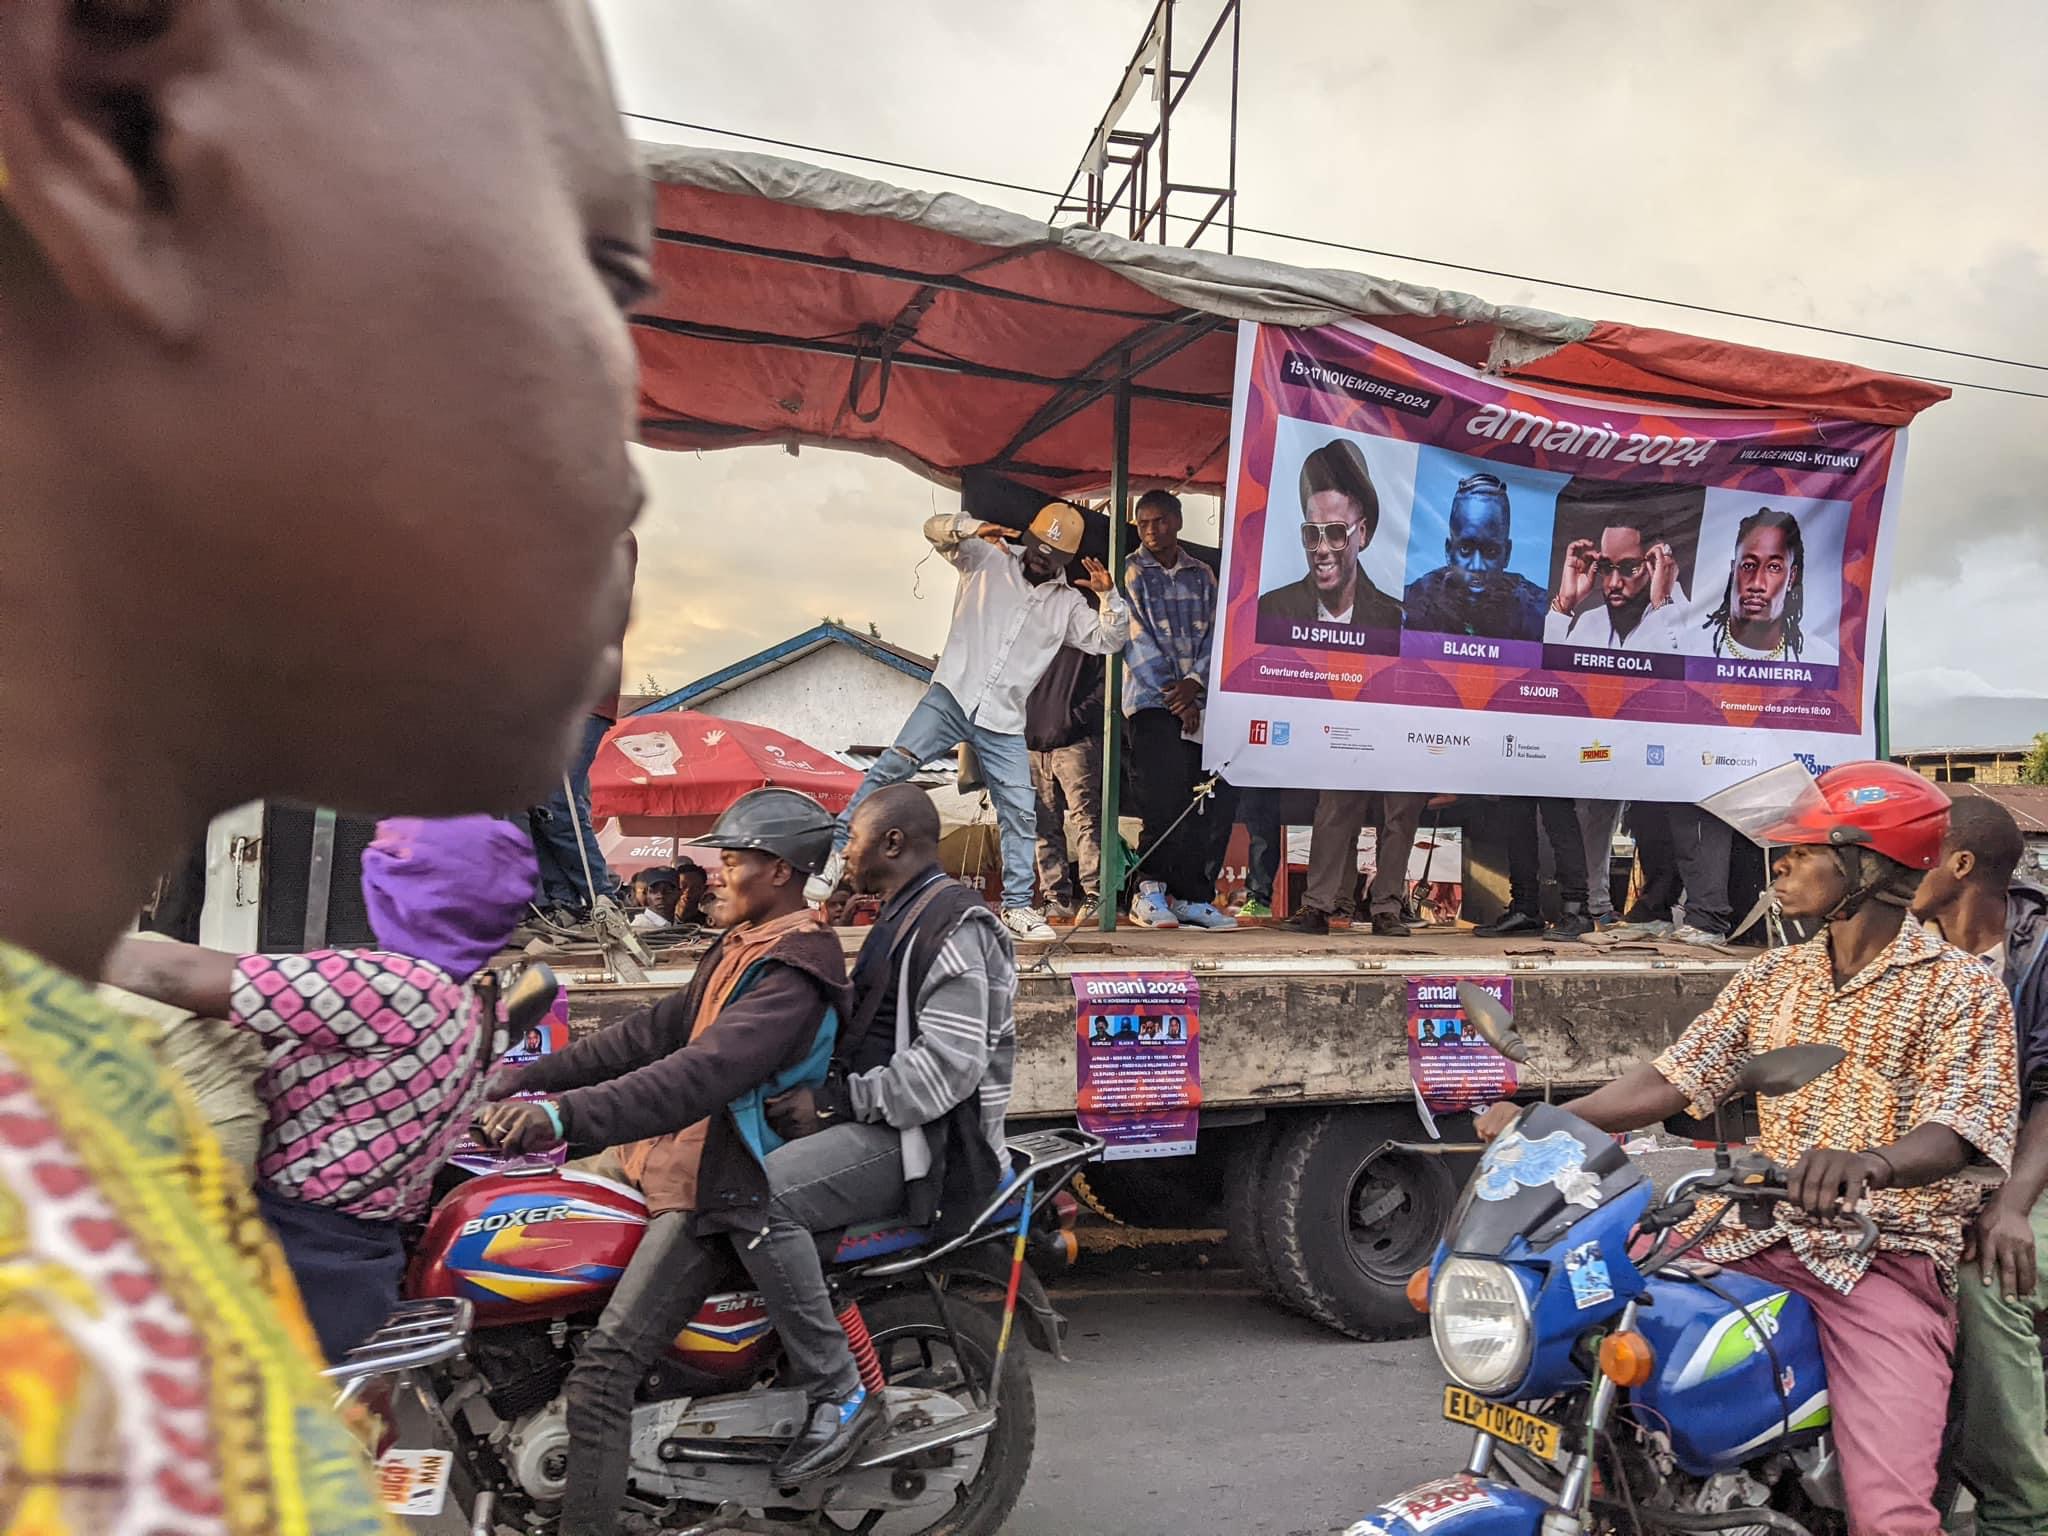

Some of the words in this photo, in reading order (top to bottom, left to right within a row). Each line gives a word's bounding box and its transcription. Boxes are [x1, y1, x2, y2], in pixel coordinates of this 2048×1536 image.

[1322, 369, 1396, 399] NOVEMBRE
[1395, 393, 1430, 409] 2024
[1465, 403, 1621, 458] amani
[1614, 433, 1717, 467] 2024
[1740, 450, 1780, 459] VILLAGE
[1779, 450, 1807, 463] IHUSI
[1814, 453, 1859, 468] KITUKU
[1048, 518, 1061, 541] LA
[1291, 625, 1309, 640] DJ
[1311, 628, 1365, 646] SPILULU
[1443, 641, 1487, 658] BLACK
[1488, 646, 1500, 659] M
[1573, 653, 1615, 669] FERRE
[1616, 657, 1652, 672] GOLA
[1260, 665, 1298, 678] Ouverture
[1300, 669, 1314, 679] des
[1314, 671, 1340, 681] portes
[1341, 672, 1363, 683] 10:00
[1717, 664, 1735, 678] RJ
[1737, 667, 1812, 682] KANIERRA
[1720, 701, 1764, 712] Fermeture
[1765, 703, 1781, 713] des
[1782, 705, 1809, 715] portes
[1811, 706, 1831, 716] 18:00
[1407, 732, 1471, 746] RAWBANK
[1583, 749, 1609, 760] PRIMUS
[630, 845, 673, 858] airtel
[1087, 978, 1146, 994] amani
[1147, 982, 1188, 994] 2024
[461, 1206, 570, 1237] BOXER
[716, 1300, 747, 1313] BM
